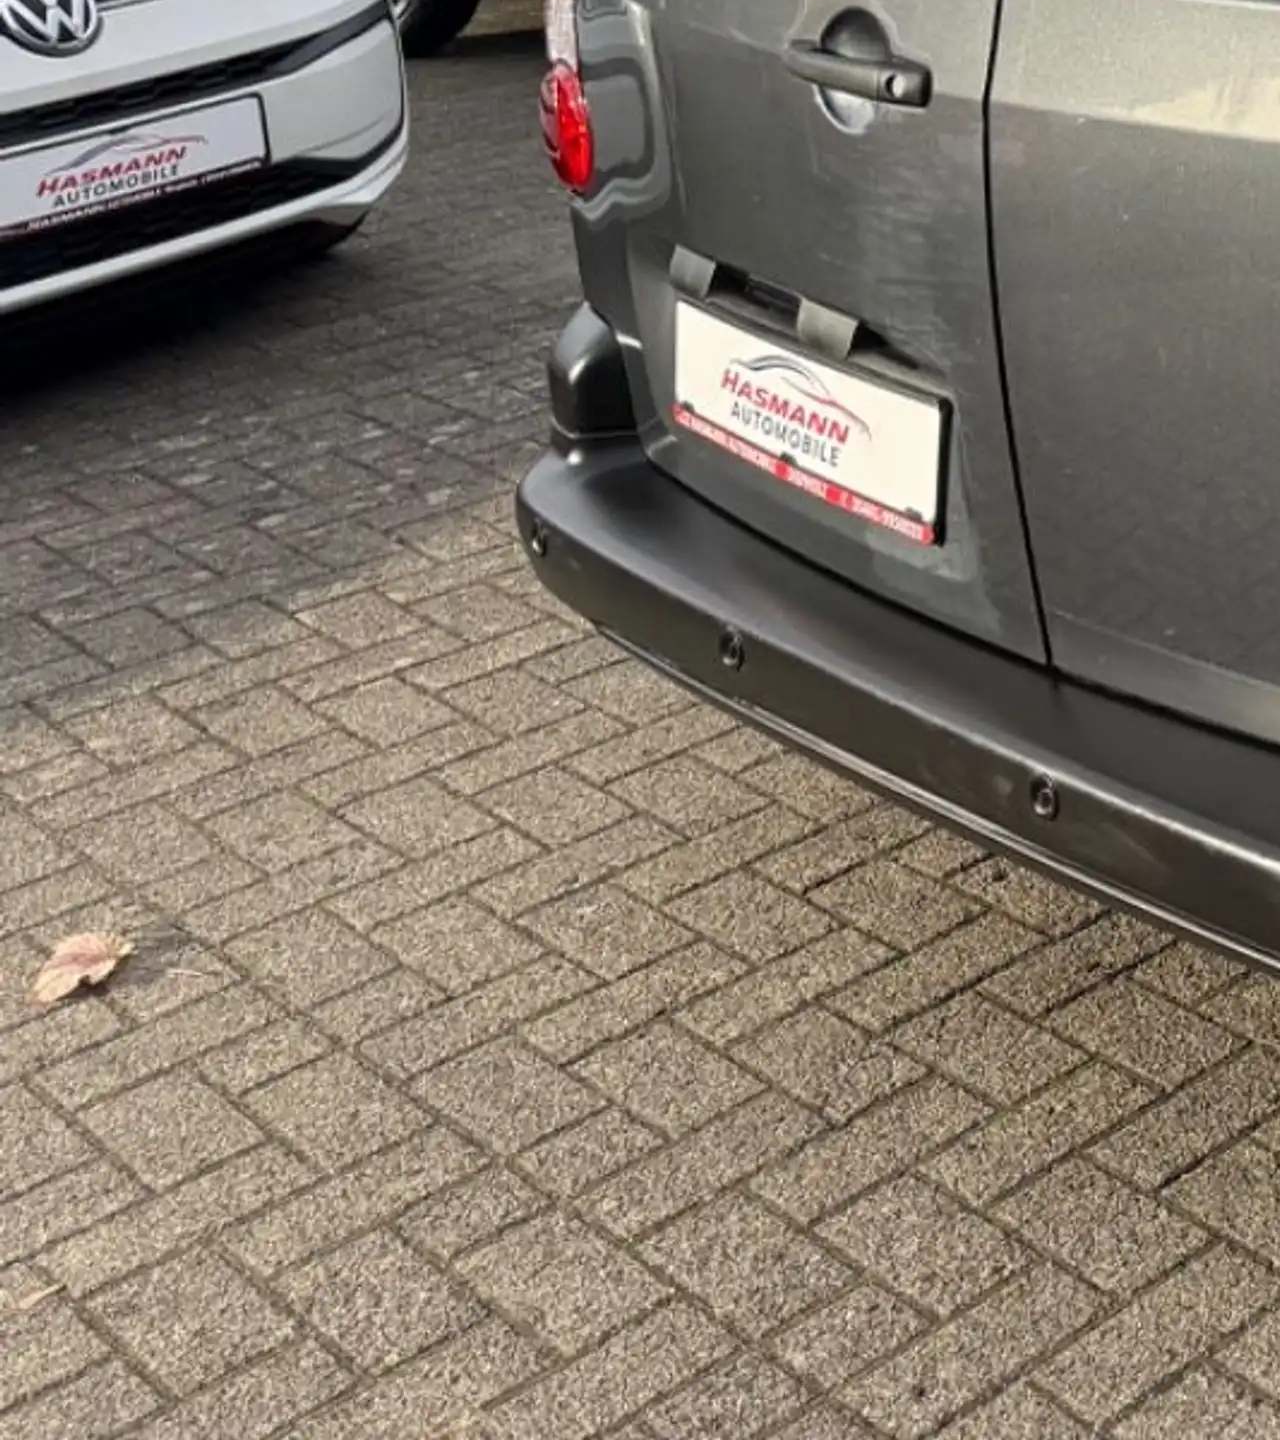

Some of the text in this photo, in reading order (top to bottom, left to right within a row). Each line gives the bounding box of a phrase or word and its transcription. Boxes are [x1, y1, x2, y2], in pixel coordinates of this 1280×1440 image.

[36, 145, 188, 198] HASMANN
[52, 162, 181, 210] AUTOMOBILE
[720, 368, 851, 446] HASMANN
[730, 402, 842, 468] AUTOMOBILE
